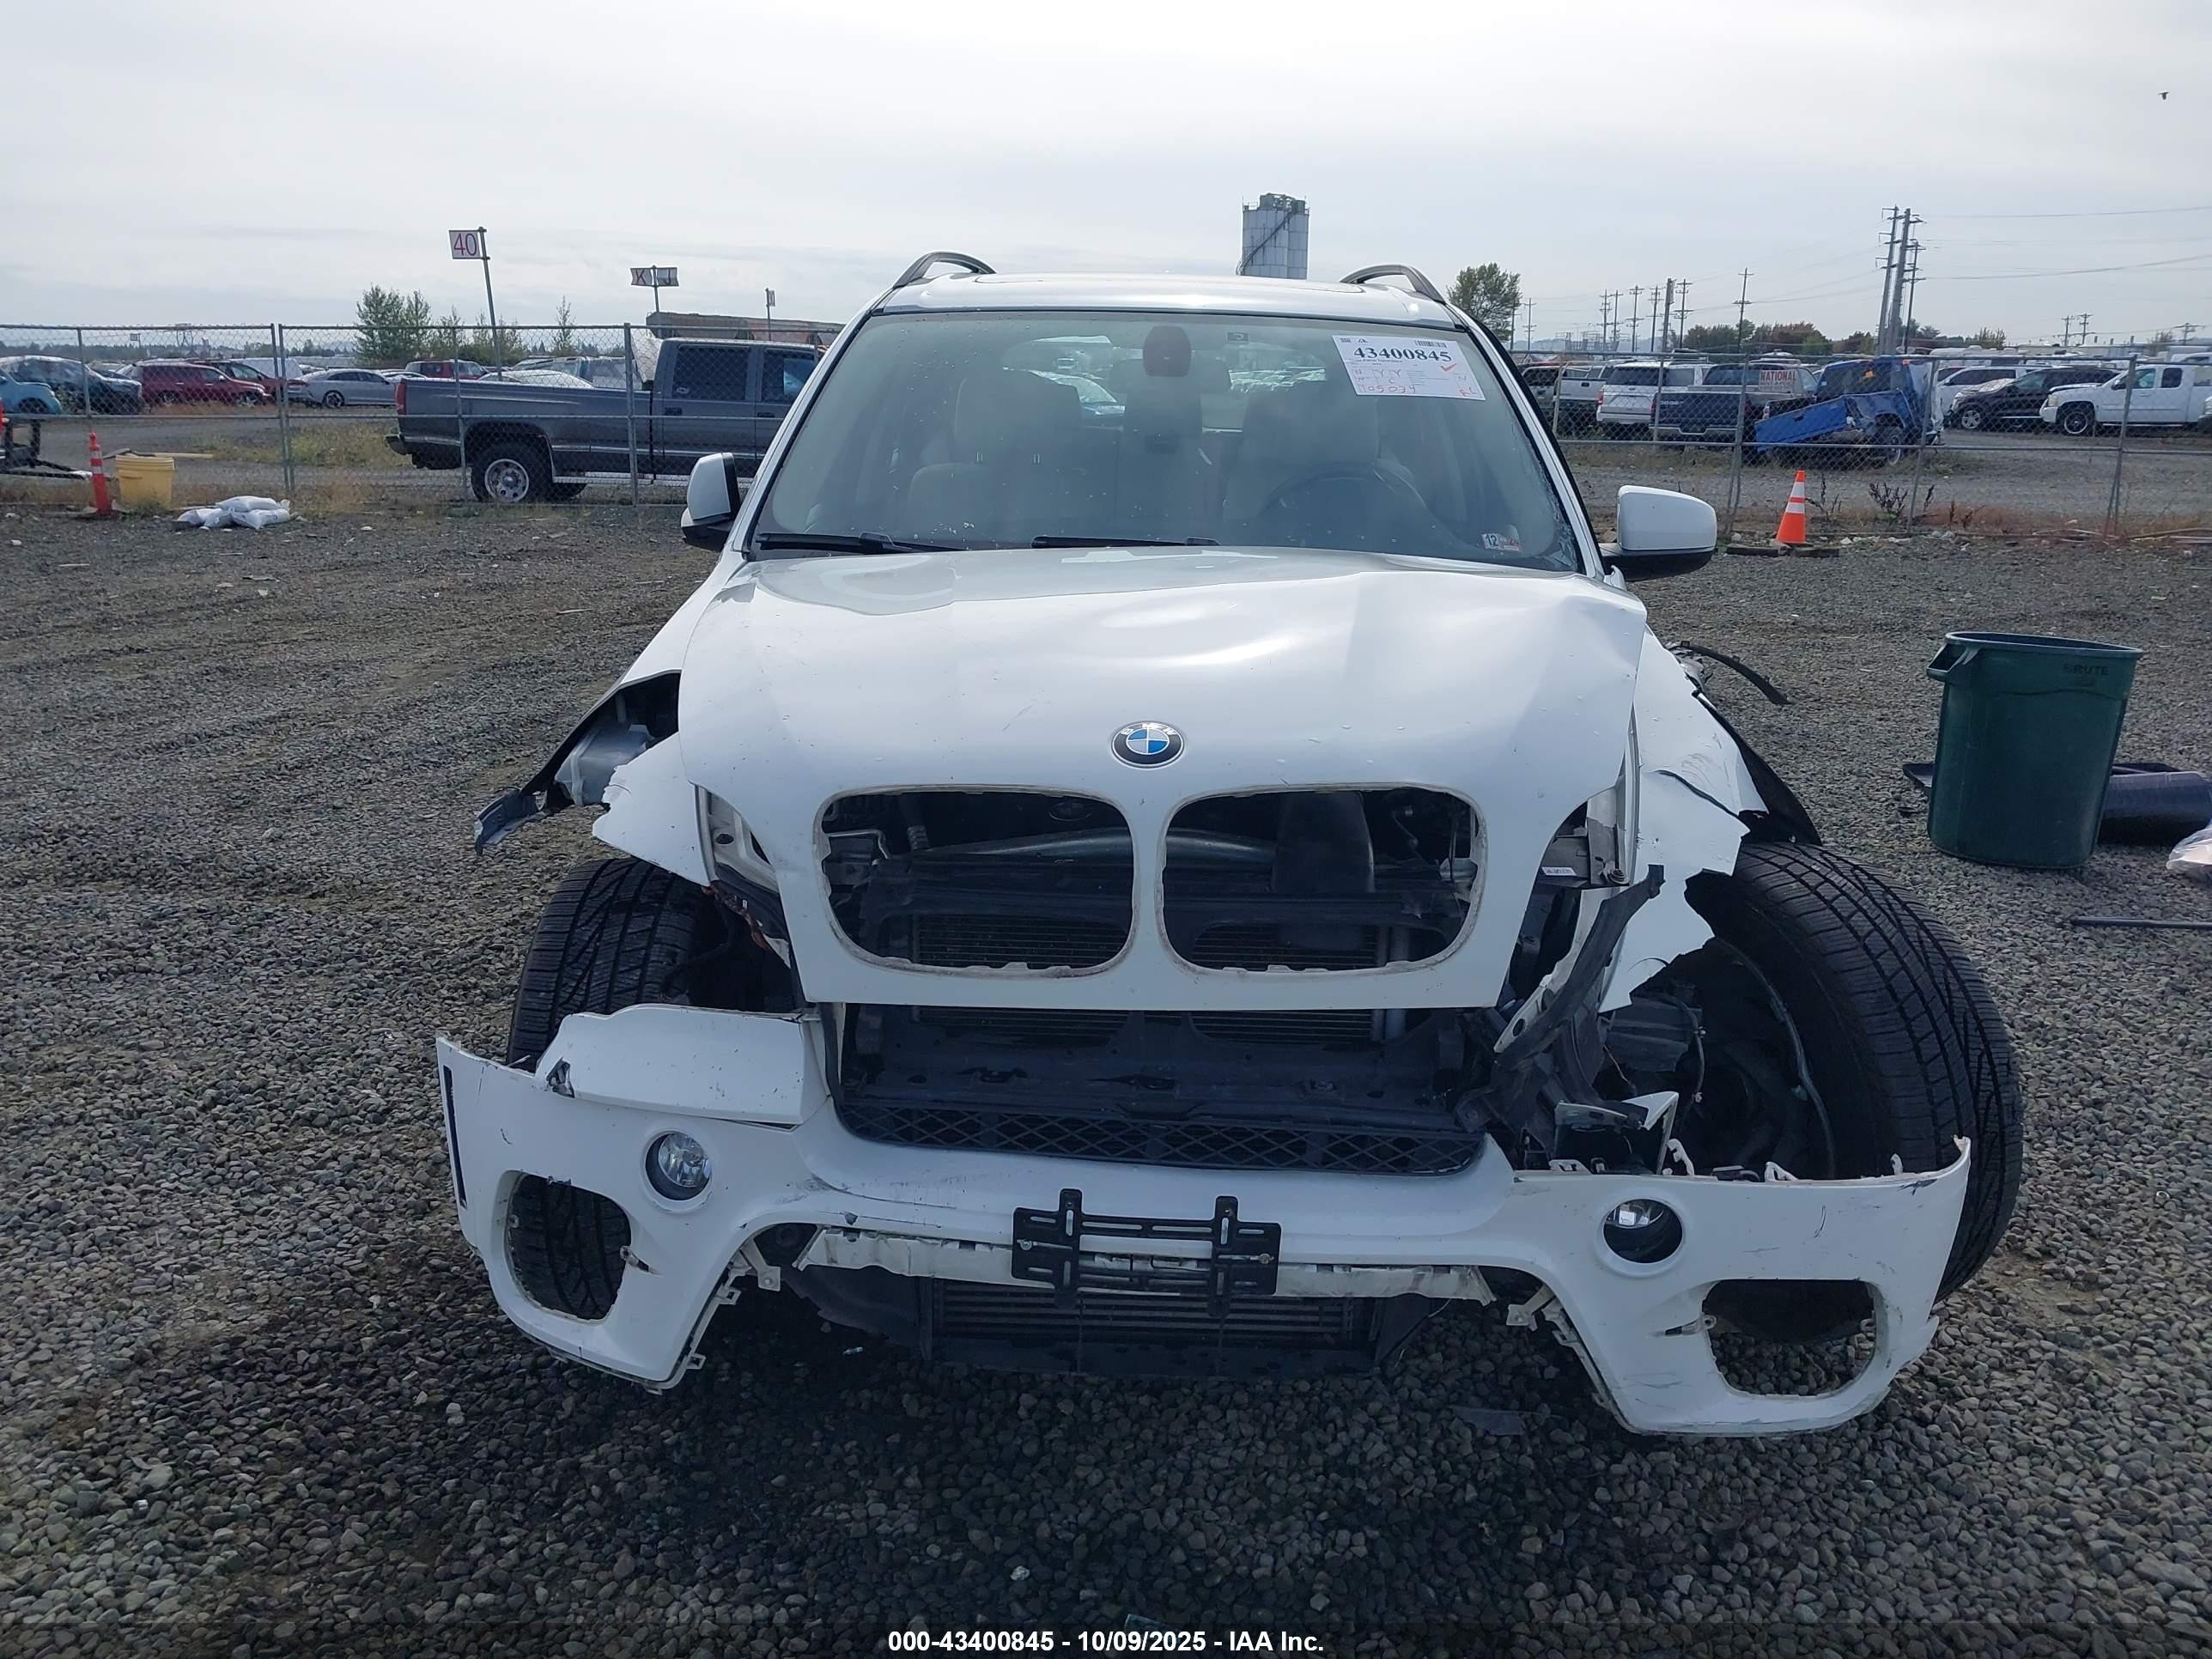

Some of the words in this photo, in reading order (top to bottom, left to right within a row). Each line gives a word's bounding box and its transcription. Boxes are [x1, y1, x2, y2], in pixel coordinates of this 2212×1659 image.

[453, 233, 477, 257] 40
[635, 268, 647, 285] K
[662, 268, 672, 285] J
[1353, 347, 1452, 362] 43400845
[1760, 370, 1796, 381] NATIONAL
[1486, 534, 1499, 547] 12
[2062, 663, 2110, 676] BRUTE
